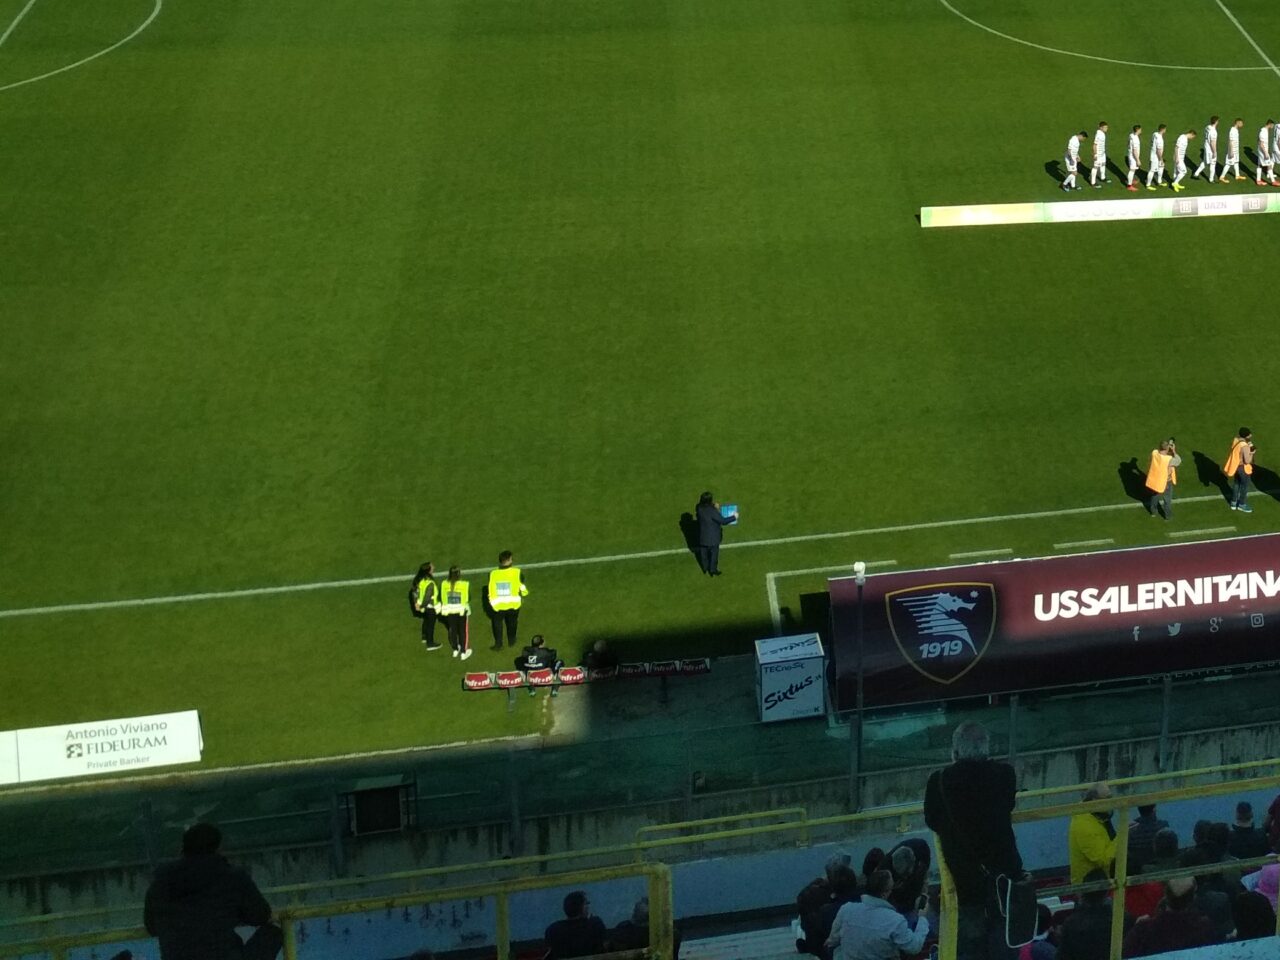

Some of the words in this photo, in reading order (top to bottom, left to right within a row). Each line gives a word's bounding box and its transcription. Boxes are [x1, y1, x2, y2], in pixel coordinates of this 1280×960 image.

[919, 640, 963, 658] 1919
[66, 727, 118, 741] Antonio
[120, 721, 168, 736] Viviano
[87, 736, 168, 756] FIDEURAM
[87, 758, 118, 769] Private
[119, 756, 150, 767] Banker
